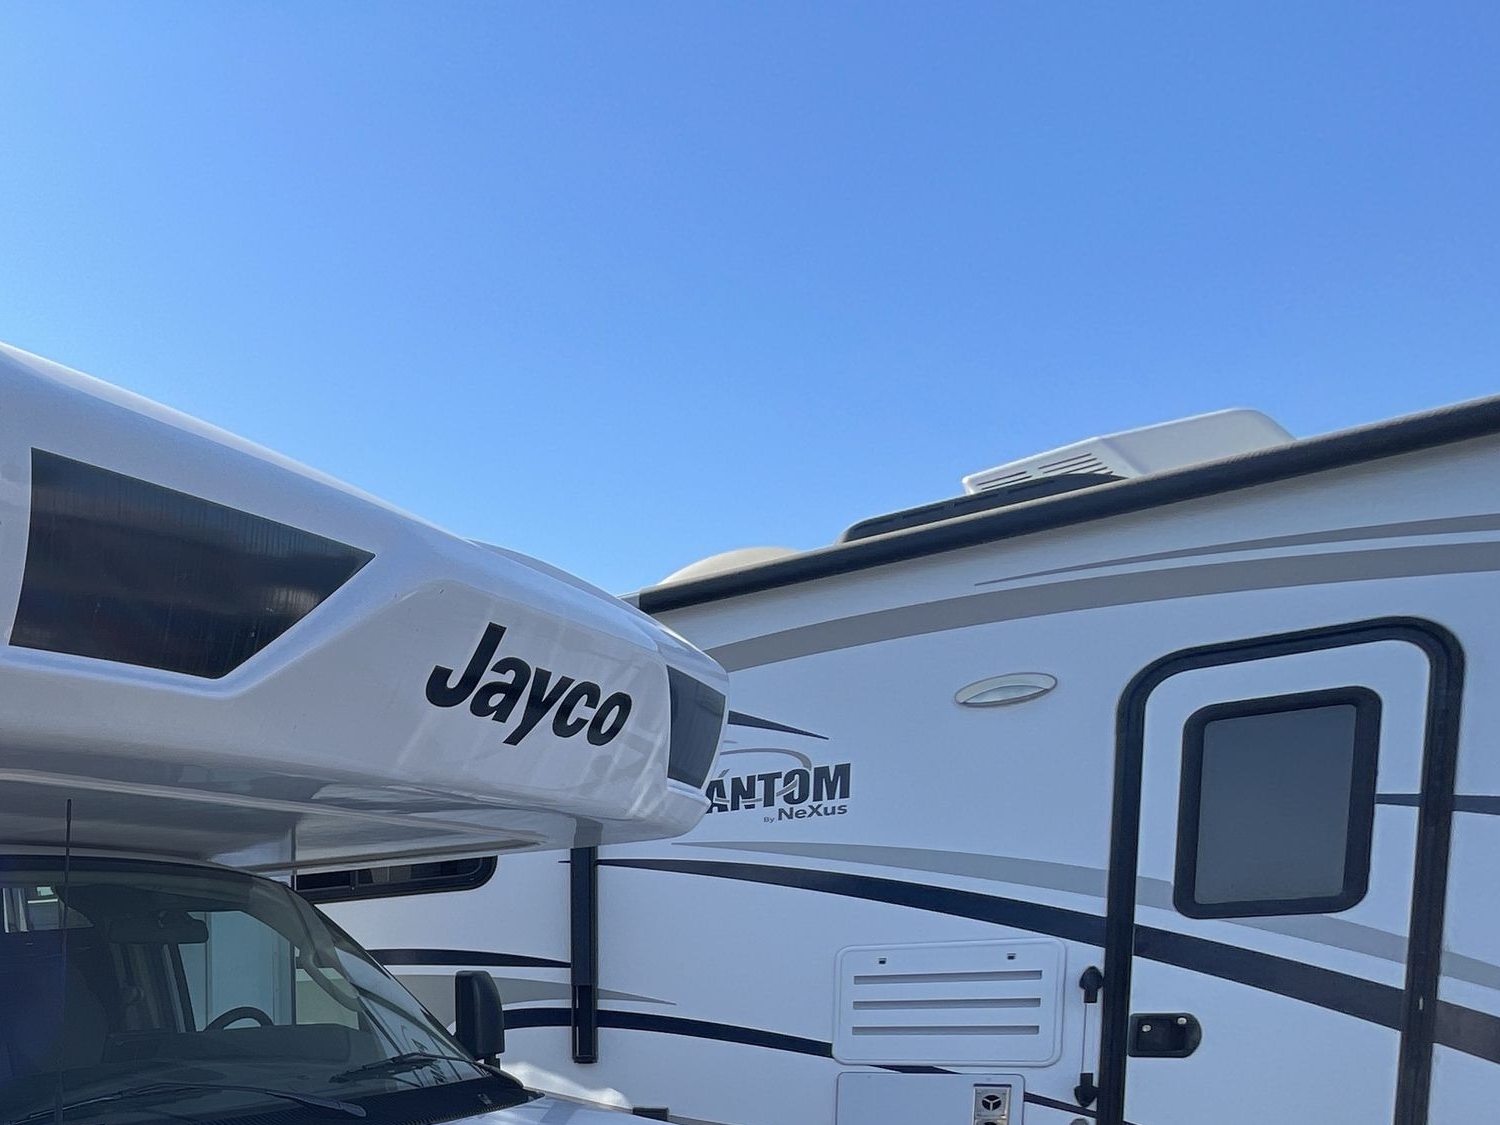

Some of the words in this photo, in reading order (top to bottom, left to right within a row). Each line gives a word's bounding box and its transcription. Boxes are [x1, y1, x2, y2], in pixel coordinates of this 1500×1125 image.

[425, 621, 632, 746] Jayco
[705, 763, 851, 814] ANTOM
[778, 804, 848, 821] NeXus
